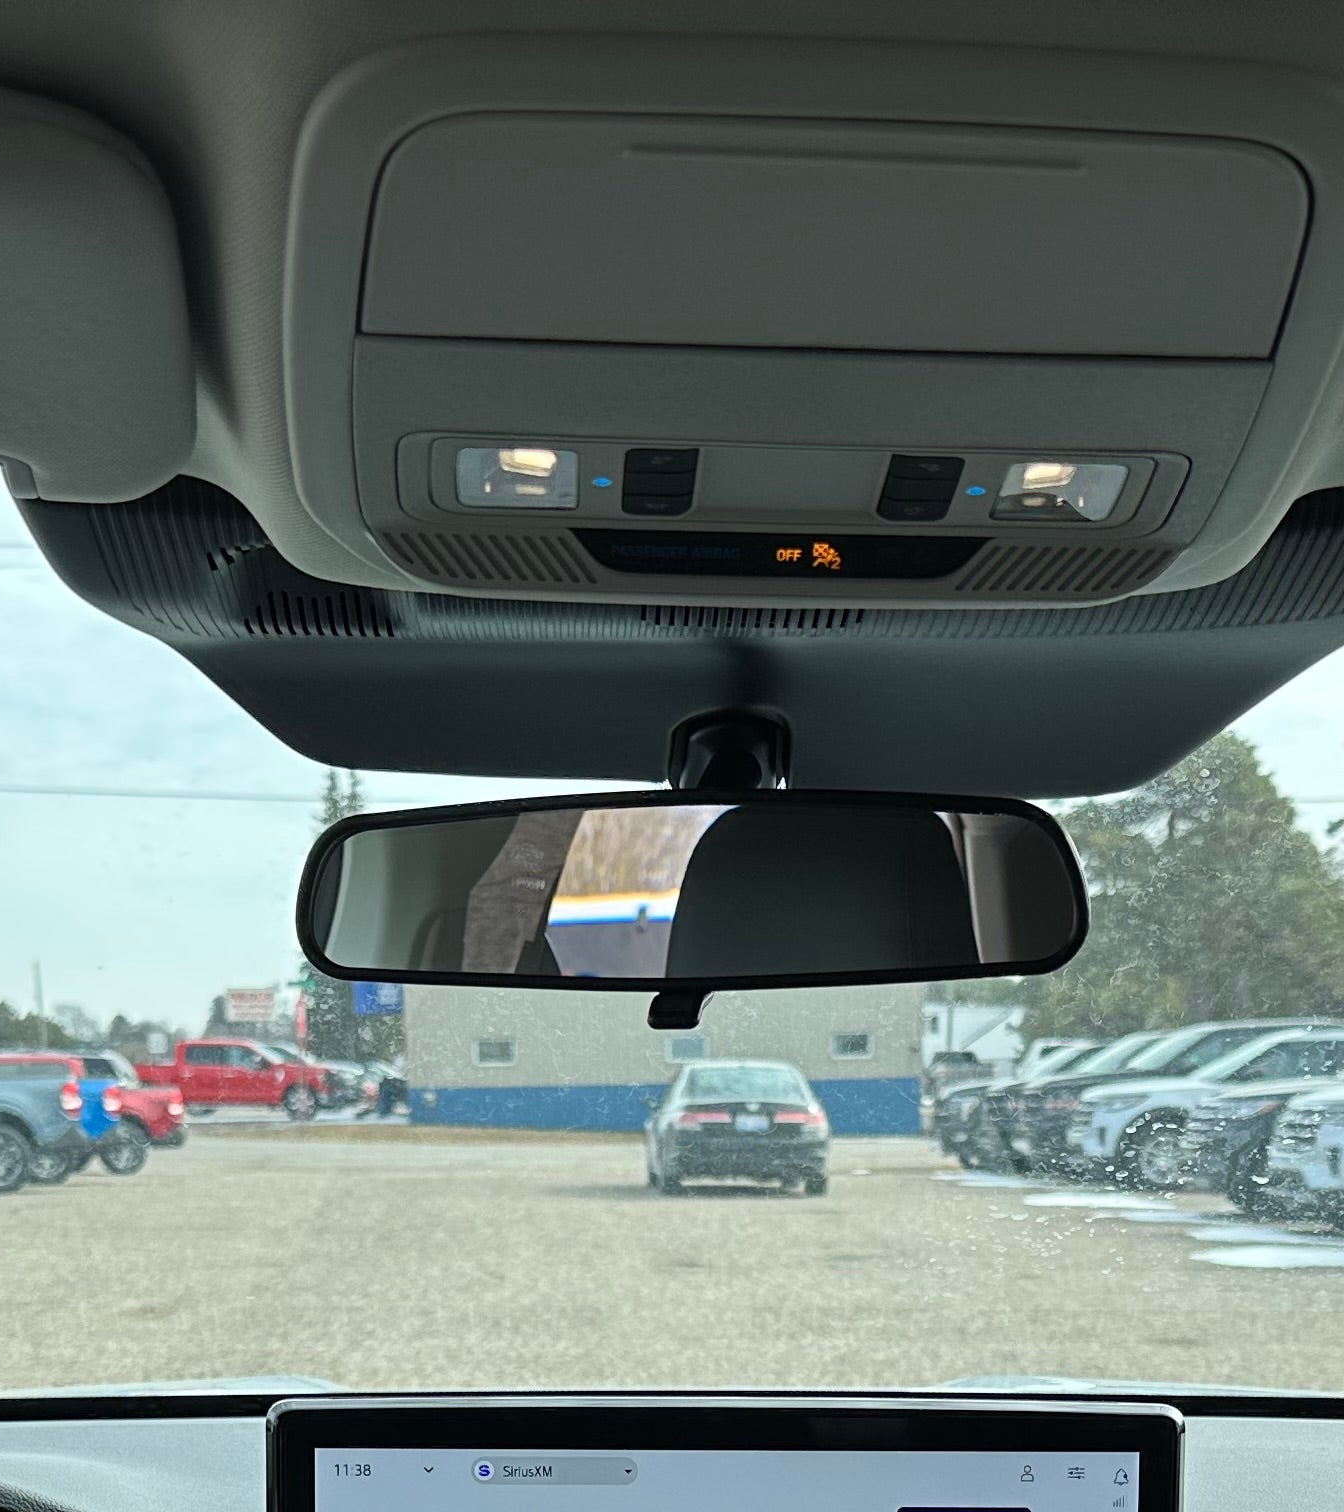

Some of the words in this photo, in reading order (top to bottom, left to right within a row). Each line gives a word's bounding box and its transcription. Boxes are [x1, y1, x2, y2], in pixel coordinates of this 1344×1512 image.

[775, 549, 803, 562] OFF
[334, 1464, 372, 1477] 11:38
[502, 1465, 553, 1478] SiriusXM
